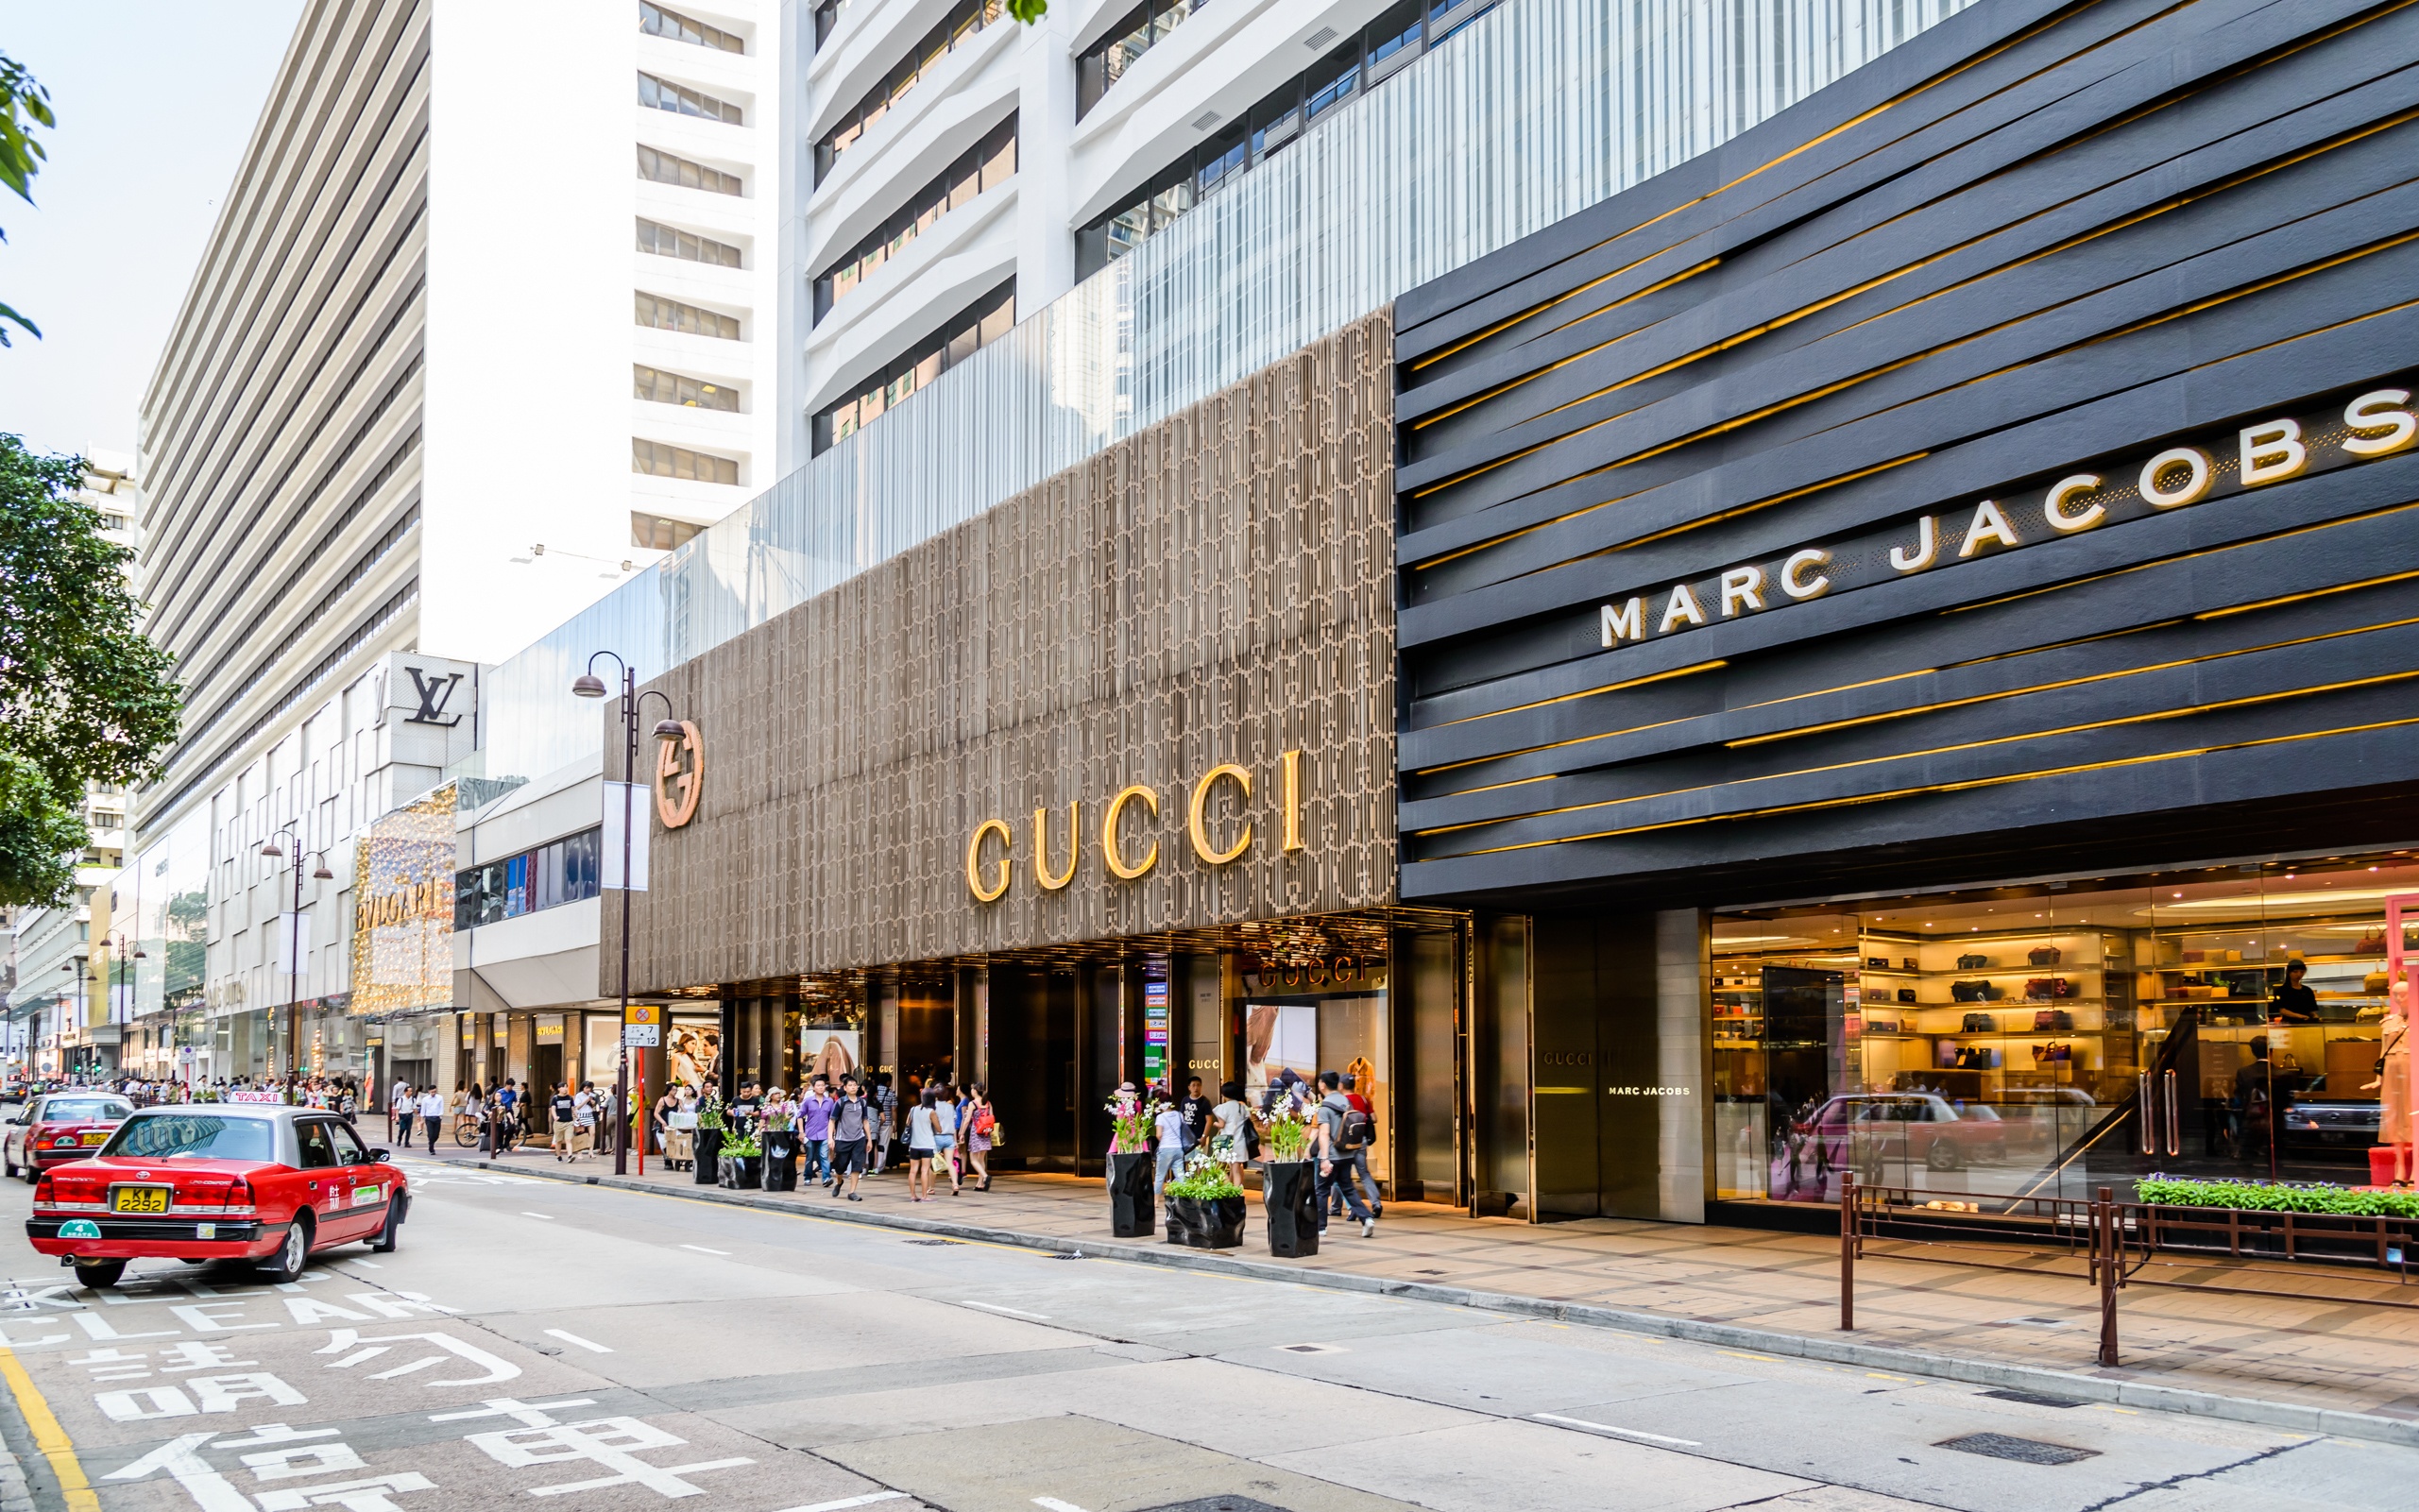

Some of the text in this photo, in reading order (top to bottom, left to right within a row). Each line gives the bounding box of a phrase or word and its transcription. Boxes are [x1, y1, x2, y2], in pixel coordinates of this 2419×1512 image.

[1600, 388, 2418, 648] MARC JACOBS
[968, 749, 1304, 902] GUCCI
[1259, 954, 1365, 988] GUCCI
[1543, 1052, 1593, 1065] GUCCI
[235, 1093, 278, 1102] TAXI
[1609, 1087, 1691, 1096] MARC JACOBS
[132, 1189, 153, 1199] KW
[121, 1199, 162, 1211] 2292
[75, 1224, 84, 1232] 4
[0, 1291, 465, 1348] CLEAR
